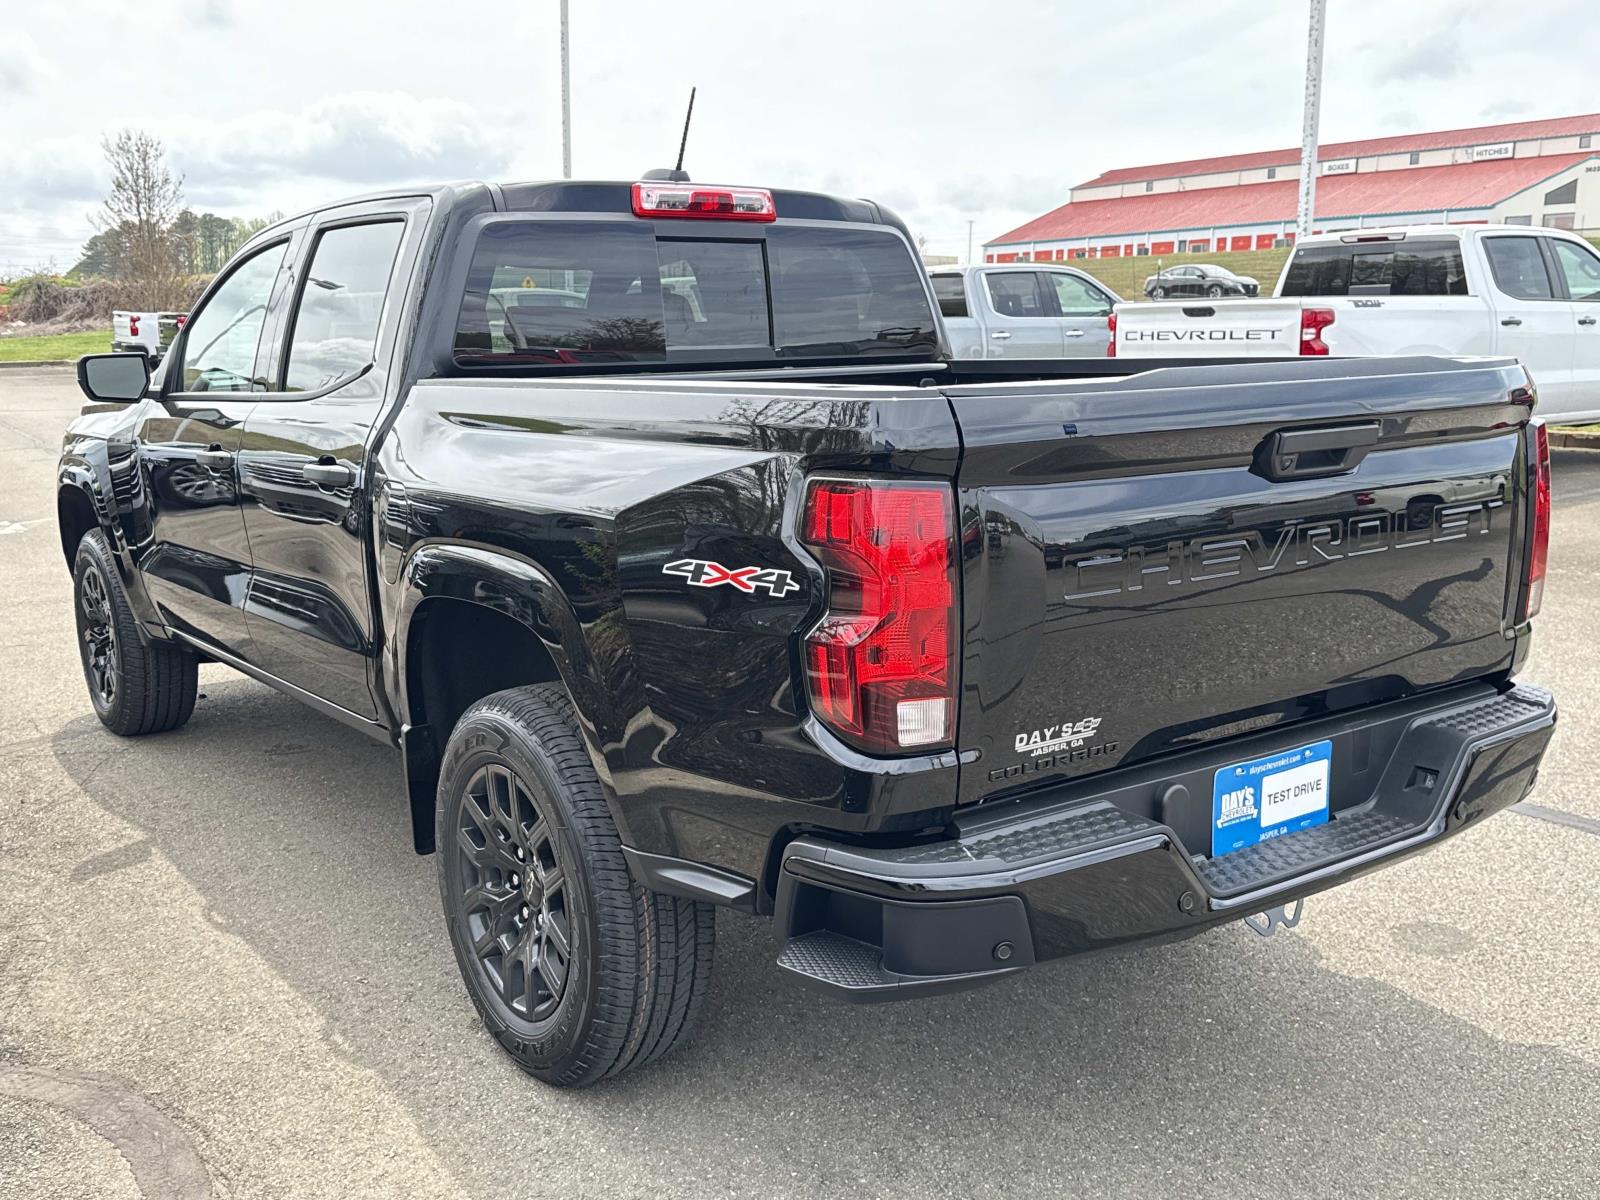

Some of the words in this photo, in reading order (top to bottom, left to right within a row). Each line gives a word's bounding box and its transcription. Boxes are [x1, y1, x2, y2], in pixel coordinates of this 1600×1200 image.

[1475, 146, 1510, 158] HITCHES
[1327, 162, 1350, 172] BOXES
[1125, 329, 1282, 341] CHEVROLET
[1063, 499, 1504, 600] CHEVROLET
[1015, 722, 1074, 747] DAY'S
[1030, 742, 1069, 757] JASPER,
[1070, 738, 1084, 748] GA
[988, 741, 1120, 782] COLORADO
[1249, 754, 1301, 775] dayschevrolet.com
[1267, 788, 1292, 806] TEST
[1294, 779, 1322, 798] DRIVE
[1279, 826, 1288, 835] GA
